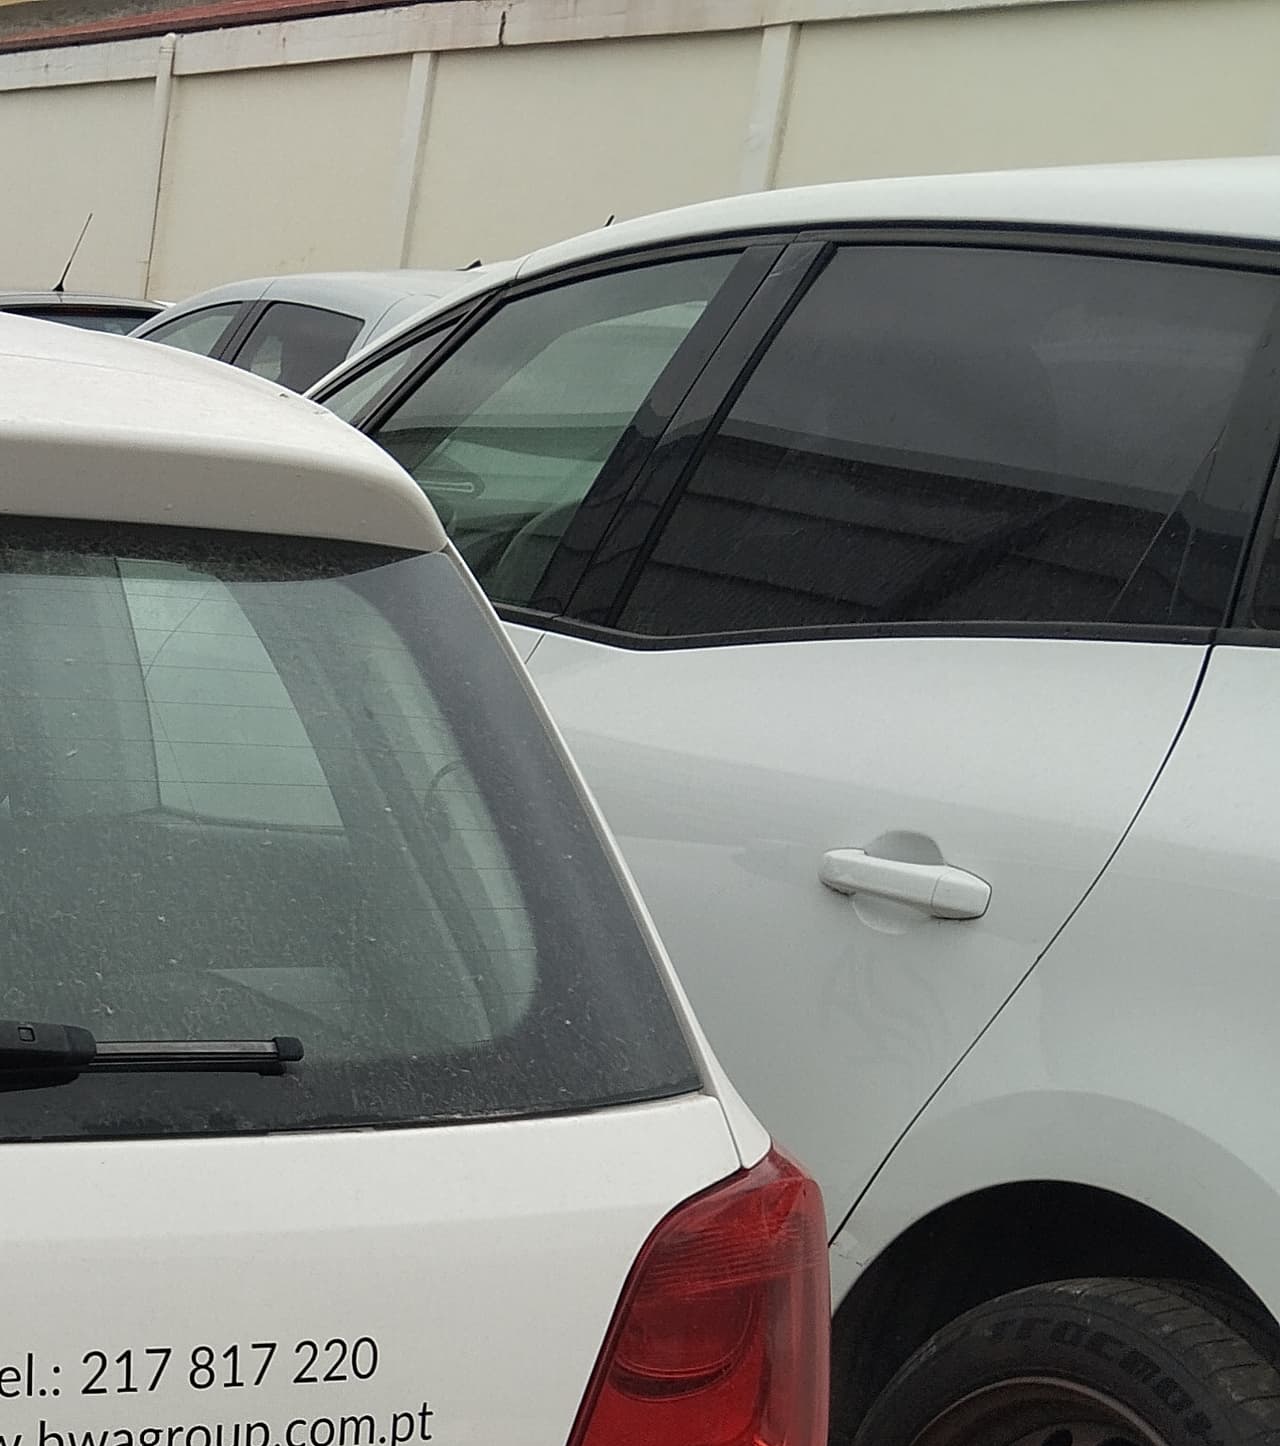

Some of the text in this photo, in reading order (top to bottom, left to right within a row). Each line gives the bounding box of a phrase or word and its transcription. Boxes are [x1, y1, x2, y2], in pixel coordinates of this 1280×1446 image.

[81, 1348, 172, 1395] 217
[189, 1343, 277, 1391] 817
[292, 1336, 378, 1384] 220
